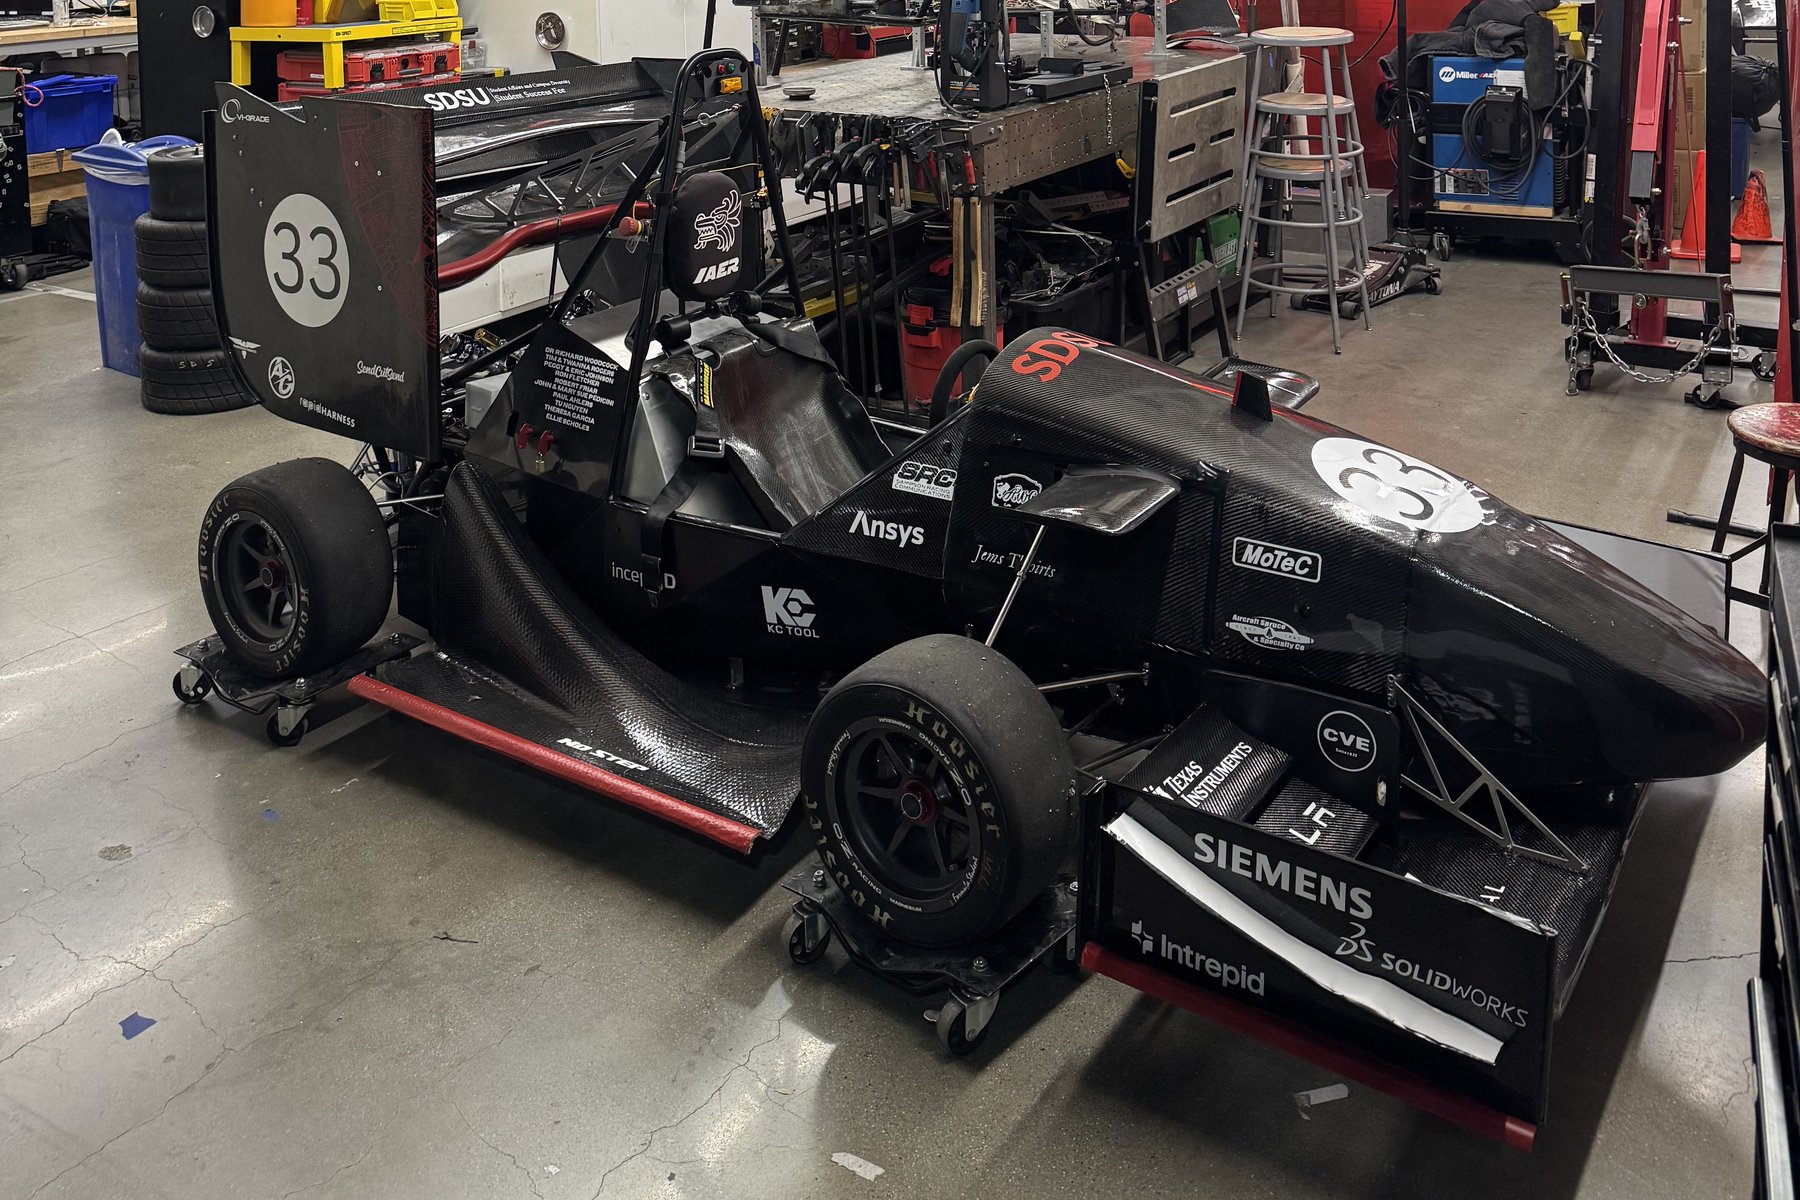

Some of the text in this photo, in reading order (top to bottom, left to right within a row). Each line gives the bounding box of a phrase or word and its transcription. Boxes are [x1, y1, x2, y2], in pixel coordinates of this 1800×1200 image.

[1456, 71, 1478, 80] Miller
[423, 87, 491, 111] SDSU
[495, 87, 567, 103] Student Success Fee
[273, 221, 341, 300] 33
[545, 346, 619, 371] DR RICHARD WOODCOCK
[545, 353, 557, 362] TIM
[563, 357, 591, 371] TWANNA
[591, 365, 615, 378] ROGERS
[356, 360, 405, 383] SendCutSend
[543, 360, 564, 371] PEGGY
[570, 367, 585, 378] ERIC
[585, 371, 614, 385] JOHNSON
[554, 369, 600, 388] RON FLETCHER
[534, 378, 552, 389] JOHN
[557, 385, 577, 396] MARY
[577, 390, 588, 399] SUE
[588, 394, 615, 407] PEDICINI
[554, 377, 598, 395] ROBERT FRIAR
[552, 391, 594, 408] PAUL AHLERS
[563, 402, 589, 415] NGUYEN
[299, 397, 356, 428] rapidHARNESS
[544, 403, 595, 425] THERESA GARCIA
[546, 412, 590, 432] ELLIE SCHOLES
[896, 460, 957, 488] SRC
[894, 483, 951, 499] COMMUNICATIONS
[849, 510, 925, 548] Ansys
[971, 544, 1005, 565] Jems
[1241, 544, 1313, 575] MoTeC
[766, 624, 820, 639] KC TOOL
[1232, 613, 1286, 631] Aircraft Spruce
[1260, 636, 1295, 650] Specialty
[1322, 726, 1371, 753] CVE
[556, 737, 650, 771] NO STEP
[1163, 760, 1204, 796] TEXAS
[1180, 741, 1253, 808] INSTRUMENTS
[1193, 832, 1374, 920] SIEMENS
[1160, 933, 1266, 997] Intrepid
[1380, 951, 1529, 1029] SOLIDWORKS
